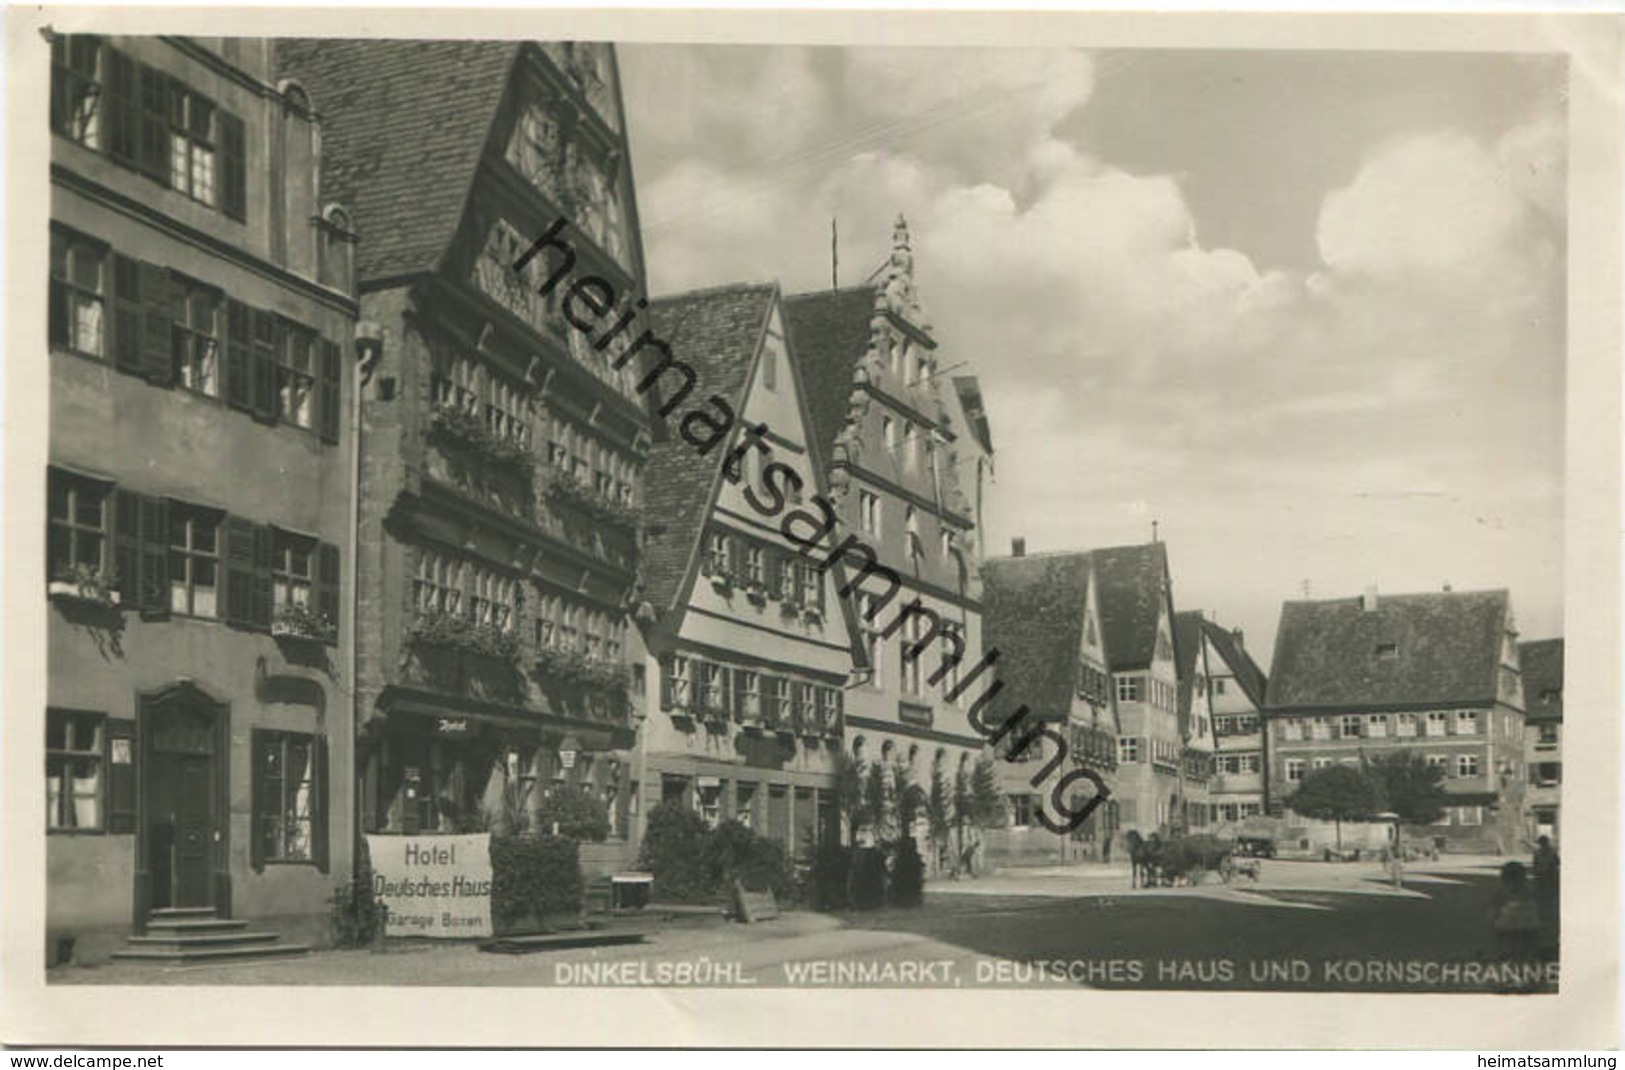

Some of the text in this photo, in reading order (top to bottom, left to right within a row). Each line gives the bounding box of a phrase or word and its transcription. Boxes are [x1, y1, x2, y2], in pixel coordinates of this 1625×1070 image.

[404, 843, 456, 866] Hotel
[374, 875, 491, 897] Deutsches Haus
